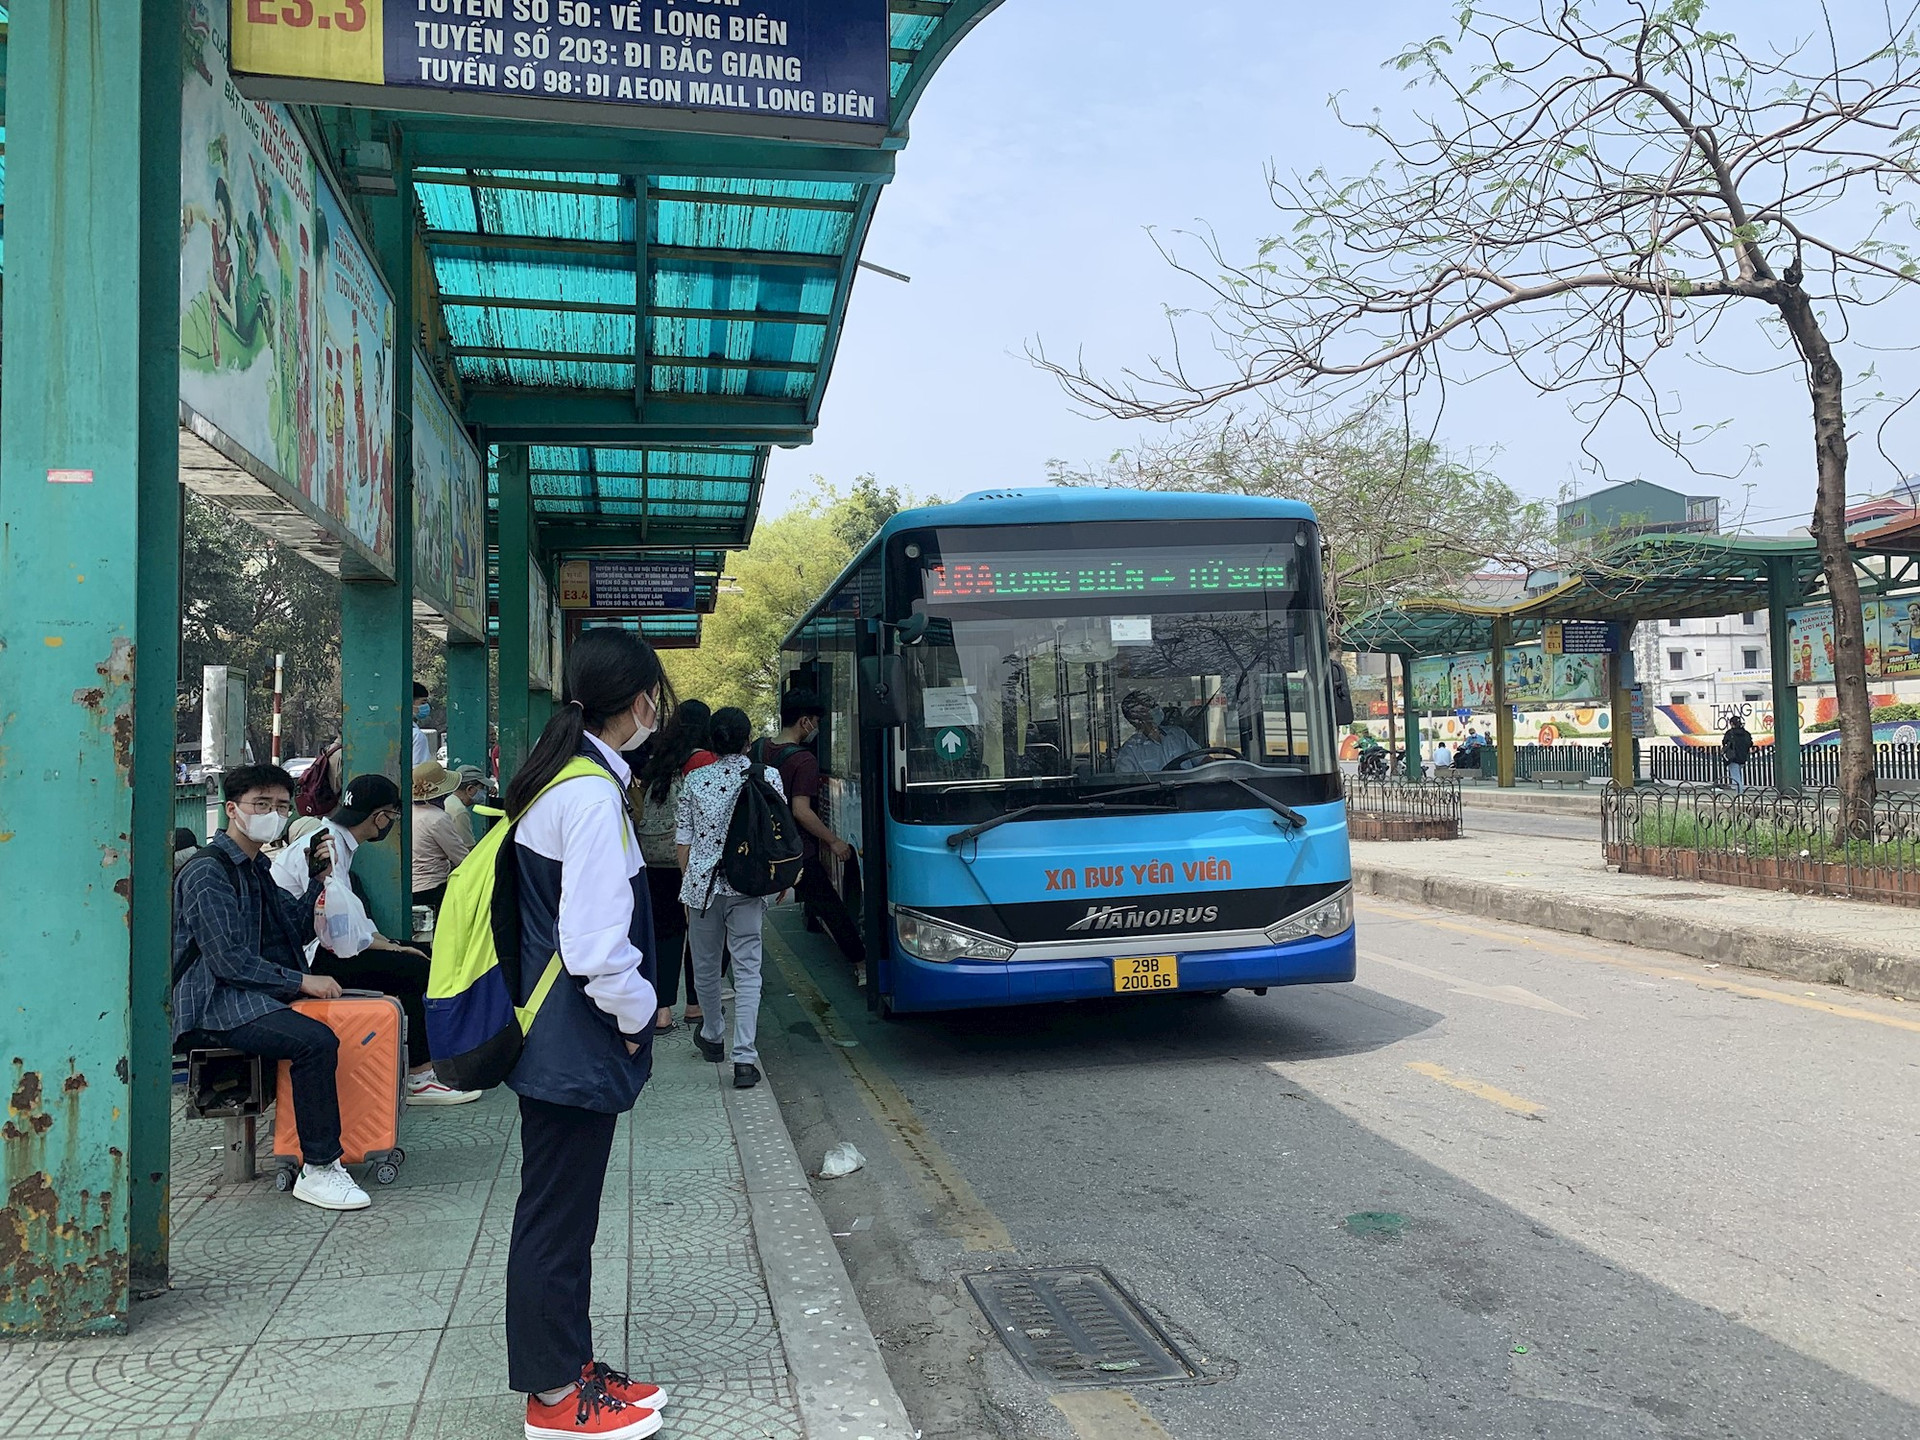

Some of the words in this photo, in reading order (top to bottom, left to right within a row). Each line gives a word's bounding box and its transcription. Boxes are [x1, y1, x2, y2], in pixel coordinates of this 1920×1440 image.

[558, 1, 601, 27] 50:
[654, 9, 721, 40] LONG
[729, 14, 787, 45] BIÊN
[414, 20, 503, 55] TUYẾN
[513, 26, 552, 59] SỐ
[559, 36, 617, 65] 203:
[624, 42, 650, 68] ĐI
[661, 38, 713, 74] BẮC
[722, 52, 802, 82] GIANG
[418, 55, 496, 87] TUYẾN
[503, 61, 539, 90] SỐ
[543, 71, 581, 93] 98:
[586, 73, 610, 97] ĐI
[617, 76, 681, 101] AEON
[689, 81, 750, 108] MALL
[757, 87, 815, 112] LONG
[822, 90, 874, 117] BIÊN
[564, 590, 588, 600] E3.4
[1045, 869, 1077, 891] XN
[1084, 865, 1125, 888] BUS
[1130, 859, 1174, 885] YÊN
[1182, 856, 1232, 882] VIÊN
[1121, 973, 1171, 990] 200.66
[1132, 959, 1159, 974] 29B
